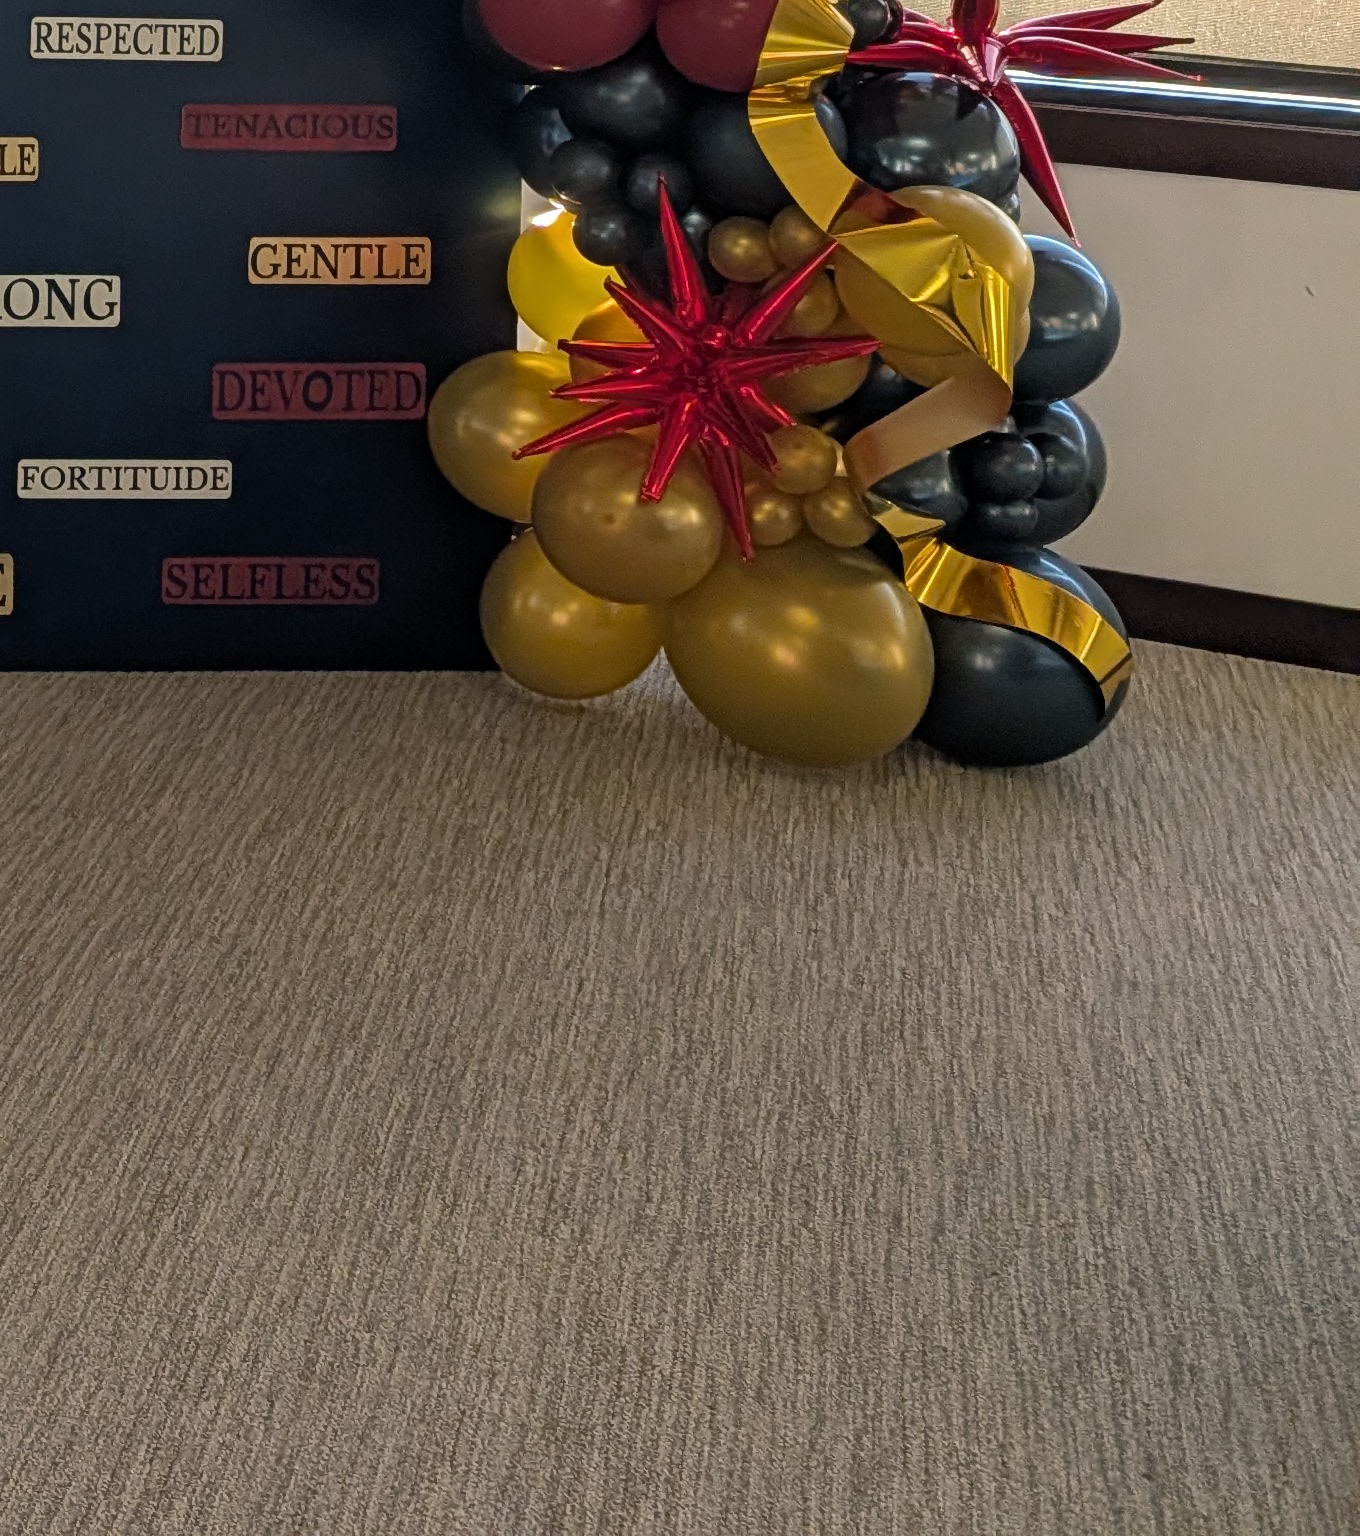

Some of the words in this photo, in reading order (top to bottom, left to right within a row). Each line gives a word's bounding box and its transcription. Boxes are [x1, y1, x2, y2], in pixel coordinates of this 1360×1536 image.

[33, 20, 220, 57] RESPECTED
[185, 112, 395, 141] TENACIOUS
[250, 242, 426, 279] GENTLE
[217, 369, 422, 414] DEVOTED
[21, 466, 229, 490] FORTITUIDE
[165, 563, 375, 600] SELFLESS
